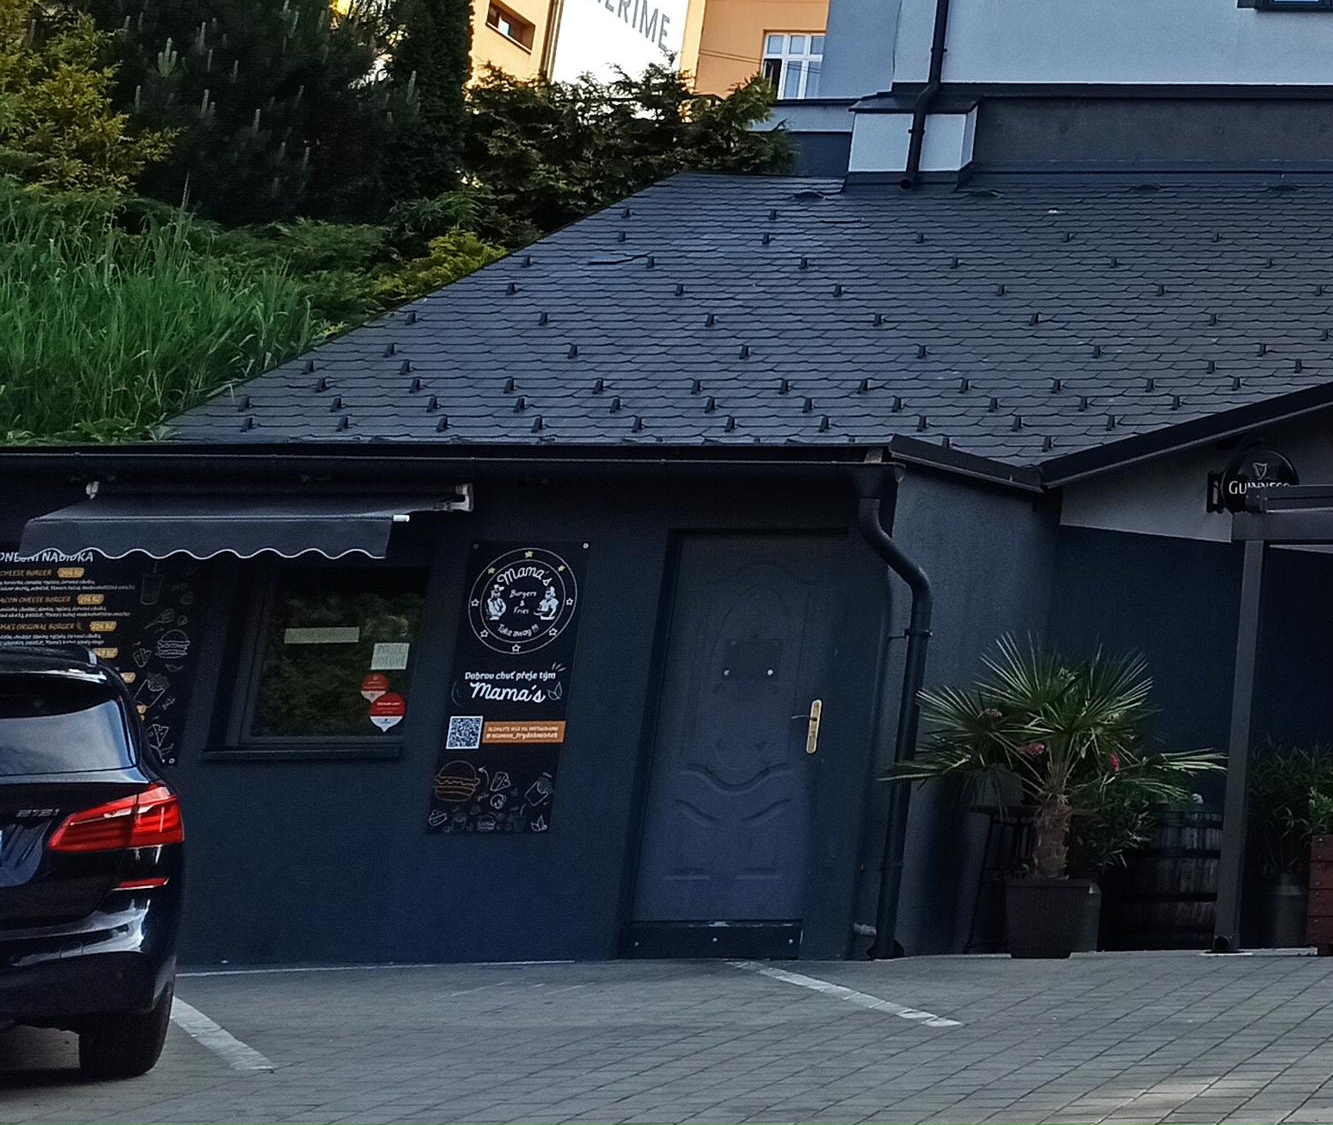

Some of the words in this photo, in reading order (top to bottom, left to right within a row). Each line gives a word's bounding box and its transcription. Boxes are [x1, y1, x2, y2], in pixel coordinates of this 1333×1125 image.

[509, 590, 537, 599] Burgers
[513, 606, 529, 614] Fries
[539, 671, 557, 682] tým
